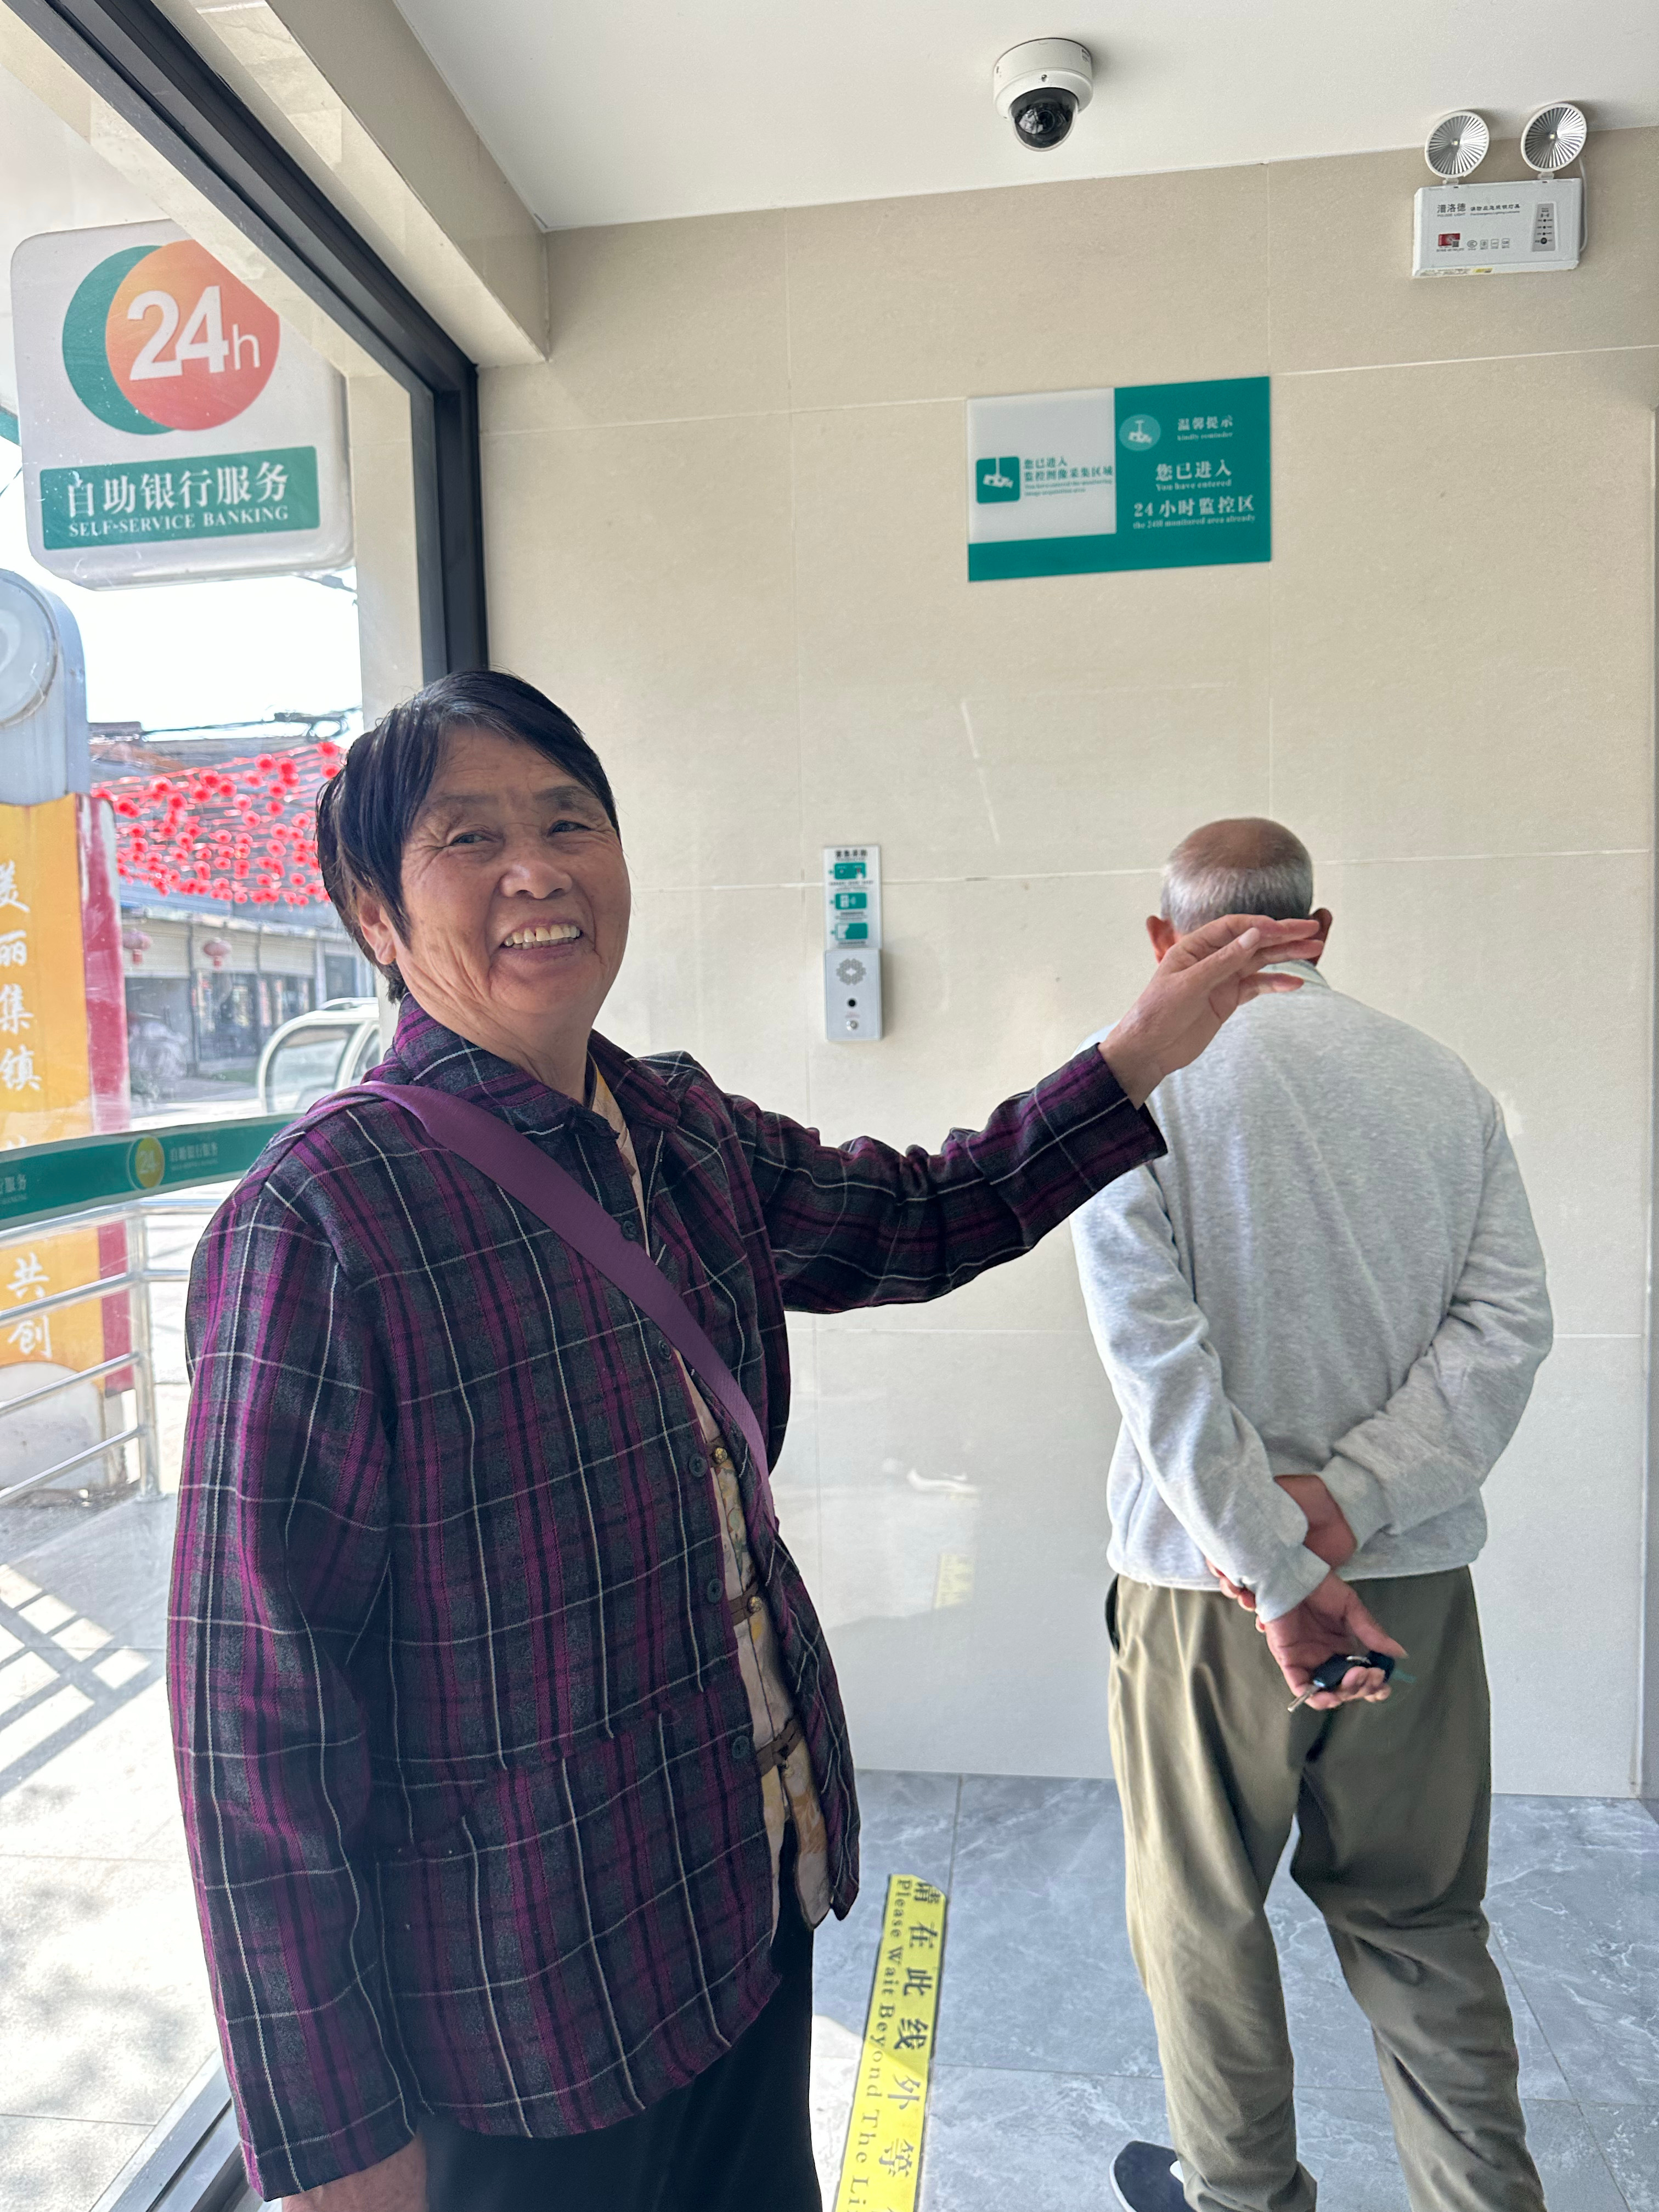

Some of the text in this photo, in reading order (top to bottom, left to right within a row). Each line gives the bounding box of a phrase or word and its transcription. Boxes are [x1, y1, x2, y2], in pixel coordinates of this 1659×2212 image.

[127, 285, 261, 381] 24h
[1178, 415, 1233, 431] 温馨提示
[1024, 456, 1068, 470] 您已进入
[1155, 459, 1232, 482] 您已进入
[68, 462, 289, 518] 自助银行服务
[1175, 482, 1196, 490] have
[1197, 479, 1232, 488] entered
[69, 505, 289, 537] SELF-SERVICE BANKING
[847, 1880, 912, 2212] Please Wait Beyond The Li
[872, 1882, 941, 2212] 请在此线外等
